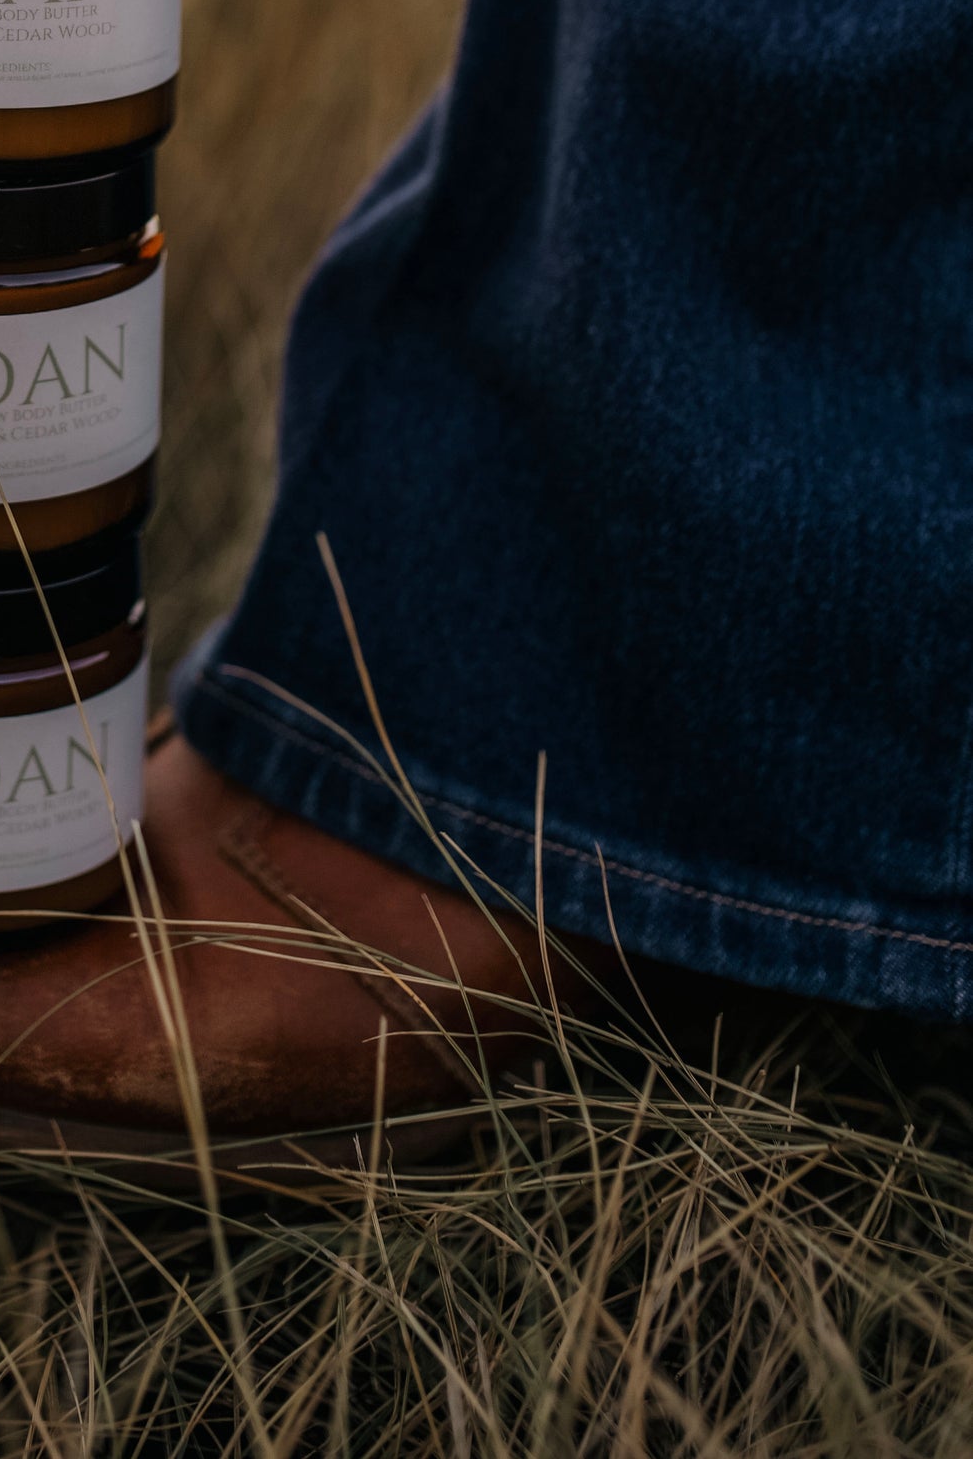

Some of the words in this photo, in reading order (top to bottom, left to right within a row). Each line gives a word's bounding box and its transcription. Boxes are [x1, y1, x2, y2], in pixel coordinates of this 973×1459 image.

[44, 4, 99, 21] BUTTER
[12, 405, 56, 422] BODY
[11, 423, 68, 441] CEDAR
